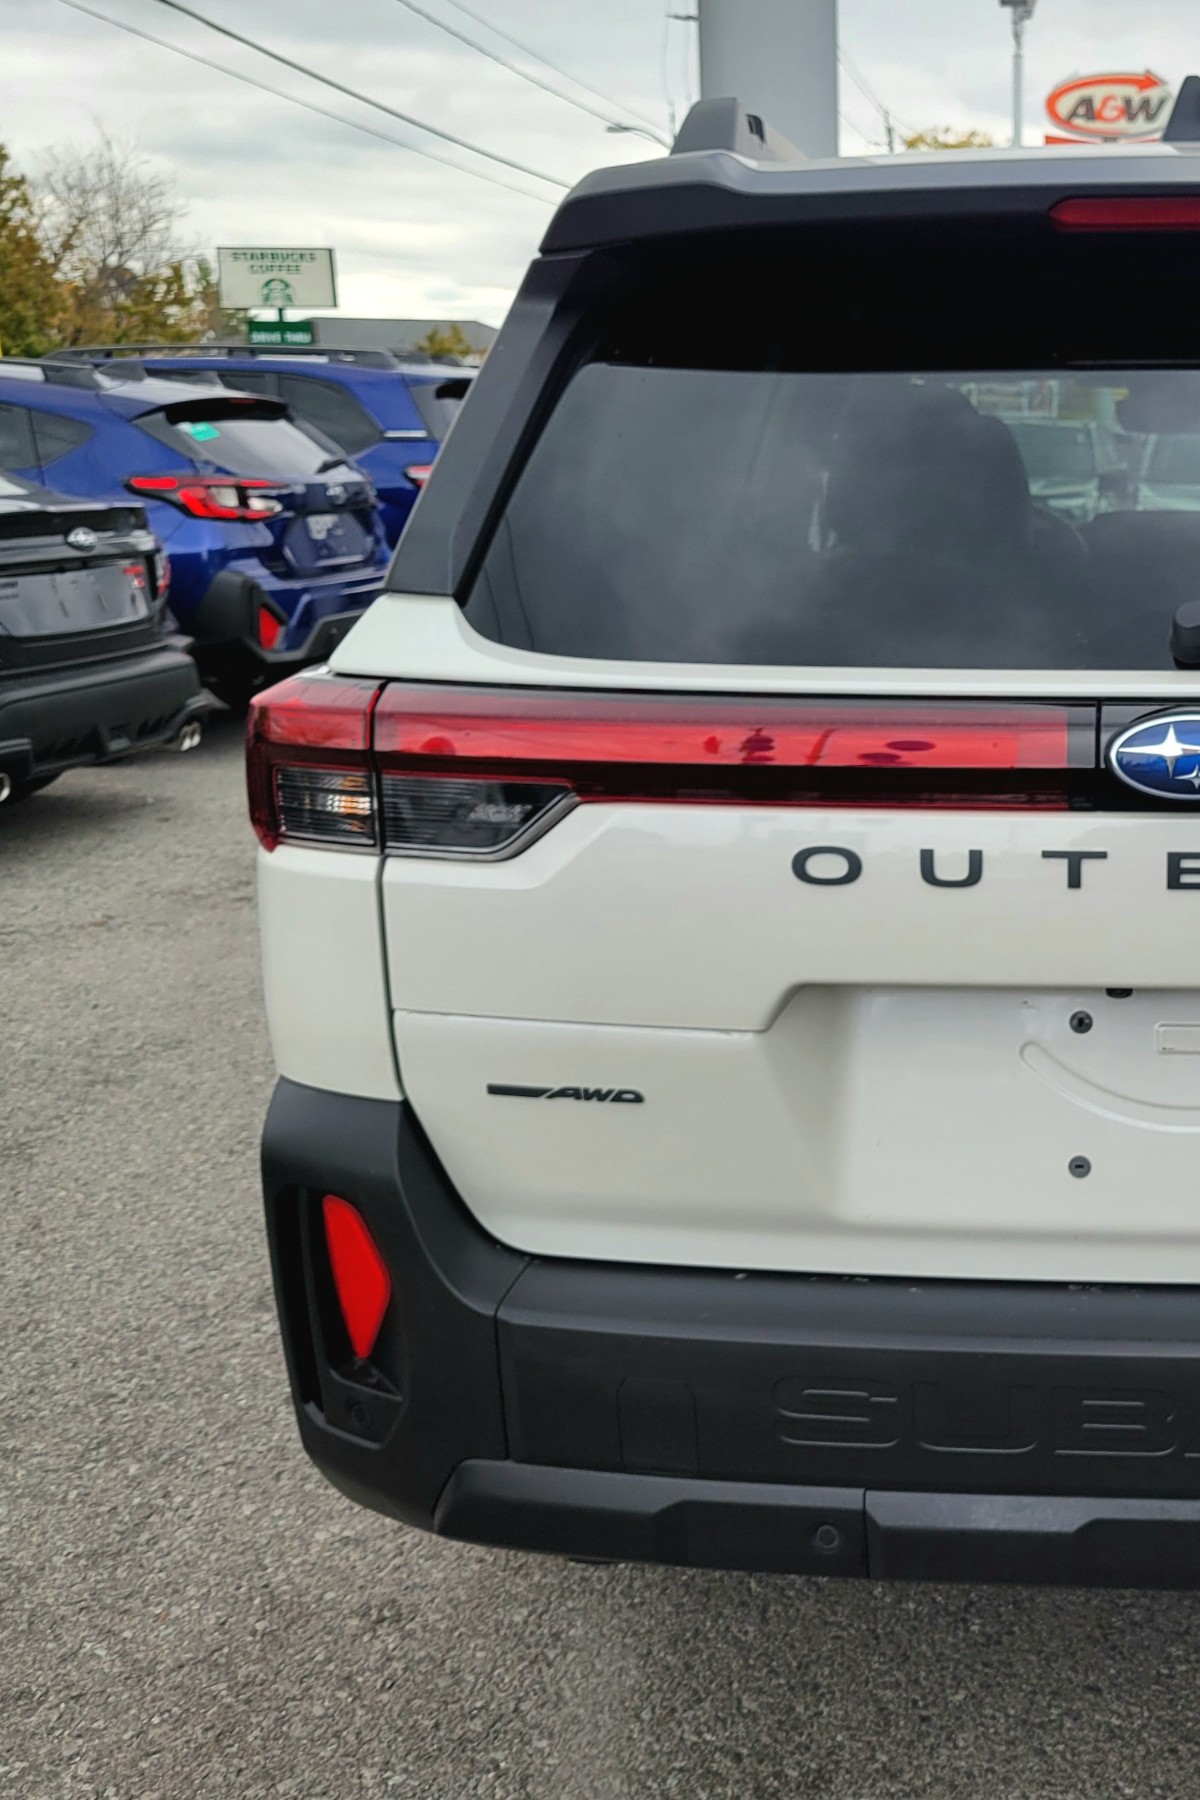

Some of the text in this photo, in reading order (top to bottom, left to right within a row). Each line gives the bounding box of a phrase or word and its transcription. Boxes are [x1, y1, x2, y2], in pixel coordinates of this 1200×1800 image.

[1067, 95, 1170, 123] A&W
[231, 251, 316, 262] STARBUCKS
[249, 264, 302, 274] COFFEE
[545, 1086, 645, 1103] AWD
